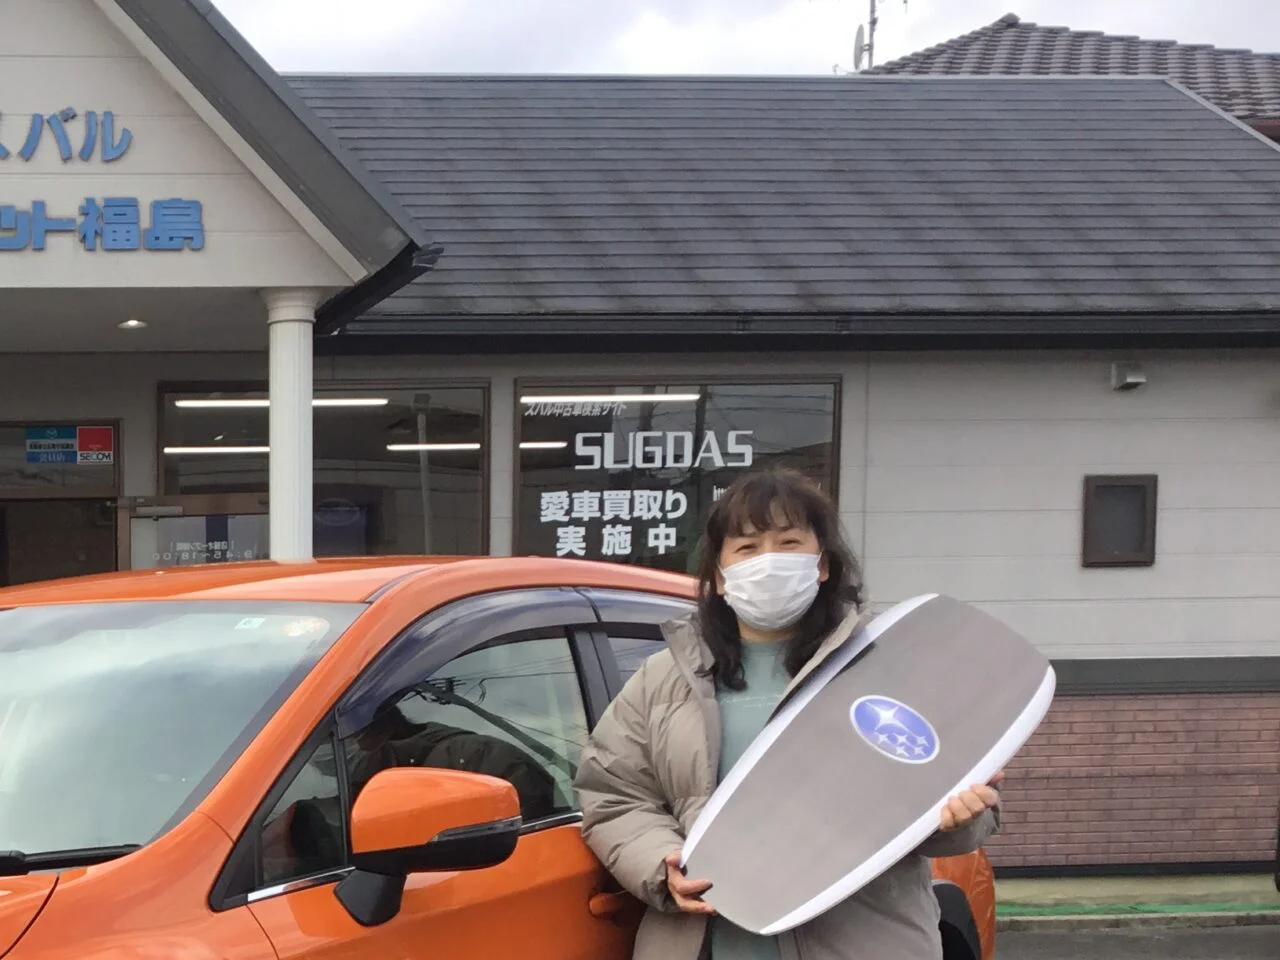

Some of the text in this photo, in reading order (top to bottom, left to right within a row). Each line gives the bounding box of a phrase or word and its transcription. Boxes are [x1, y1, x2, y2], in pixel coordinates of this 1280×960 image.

[79, 452, 112, 461] SECOM
[539, 489, 688, 523] 愛車買取り
[556, 524, 677, 557] 実施中
